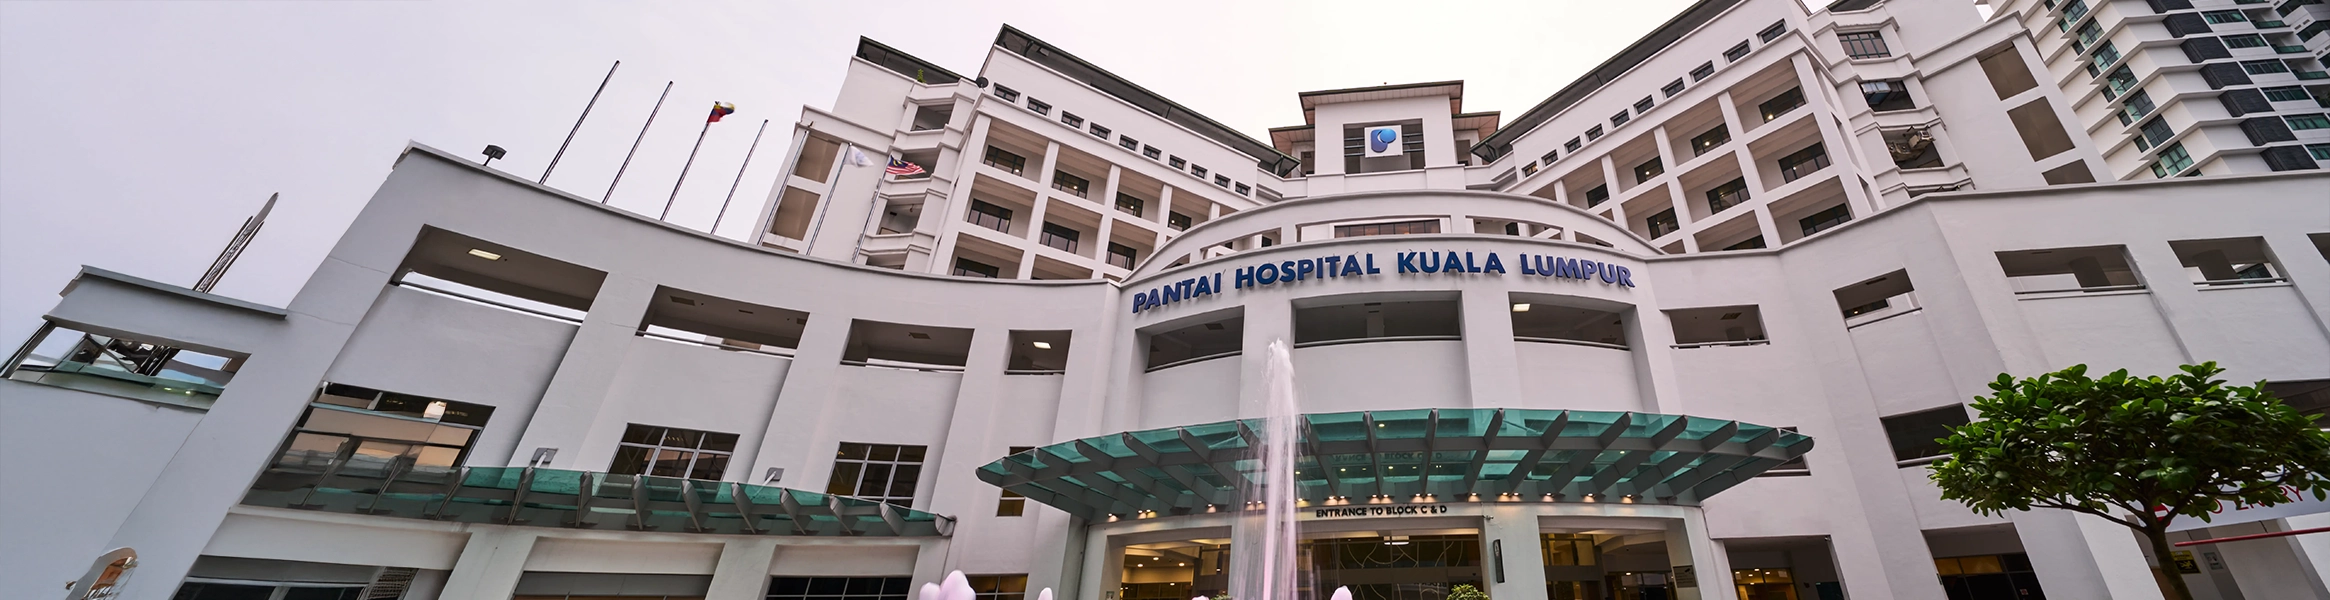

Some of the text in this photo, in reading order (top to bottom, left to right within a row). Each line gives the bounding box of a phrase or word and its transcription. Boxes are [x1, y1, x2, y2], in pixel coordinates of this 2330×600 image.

[1132, 251, 1636, 314] PANTAI HOSPITAL KUALA LUMPUR
[1316, 505, 1448, 518] ENTRANCE TO BLOCK C & D
